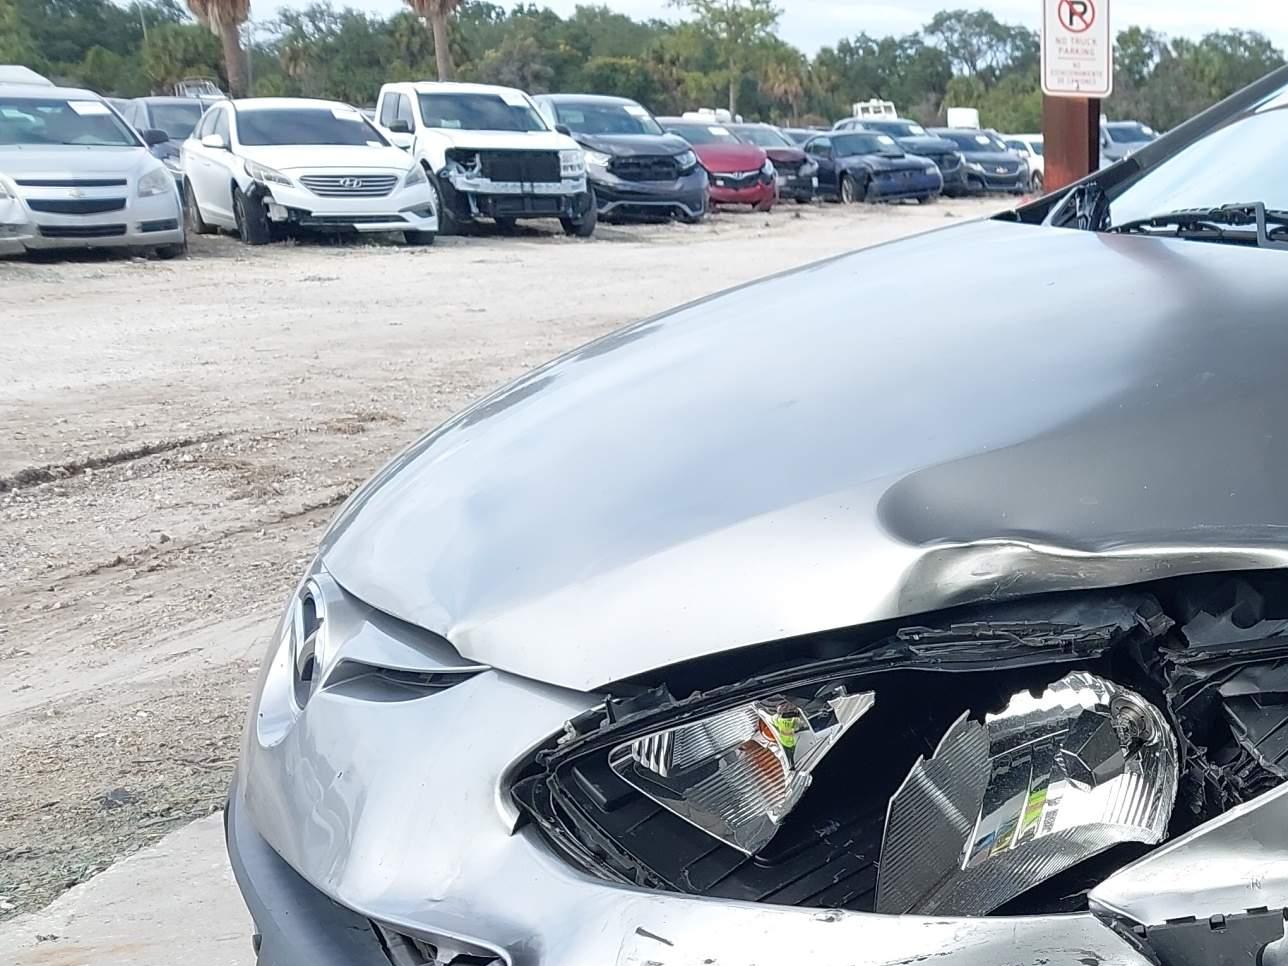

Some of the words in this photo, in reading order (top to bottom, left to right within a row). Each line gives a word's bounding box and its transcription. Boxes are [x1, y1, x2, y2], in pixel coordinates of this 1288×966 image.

[1056, 37, 1067, 45] NO
[1071, 37, 1097, 46] TRUCK
[1058, 47, 1096, 56] PARKING
